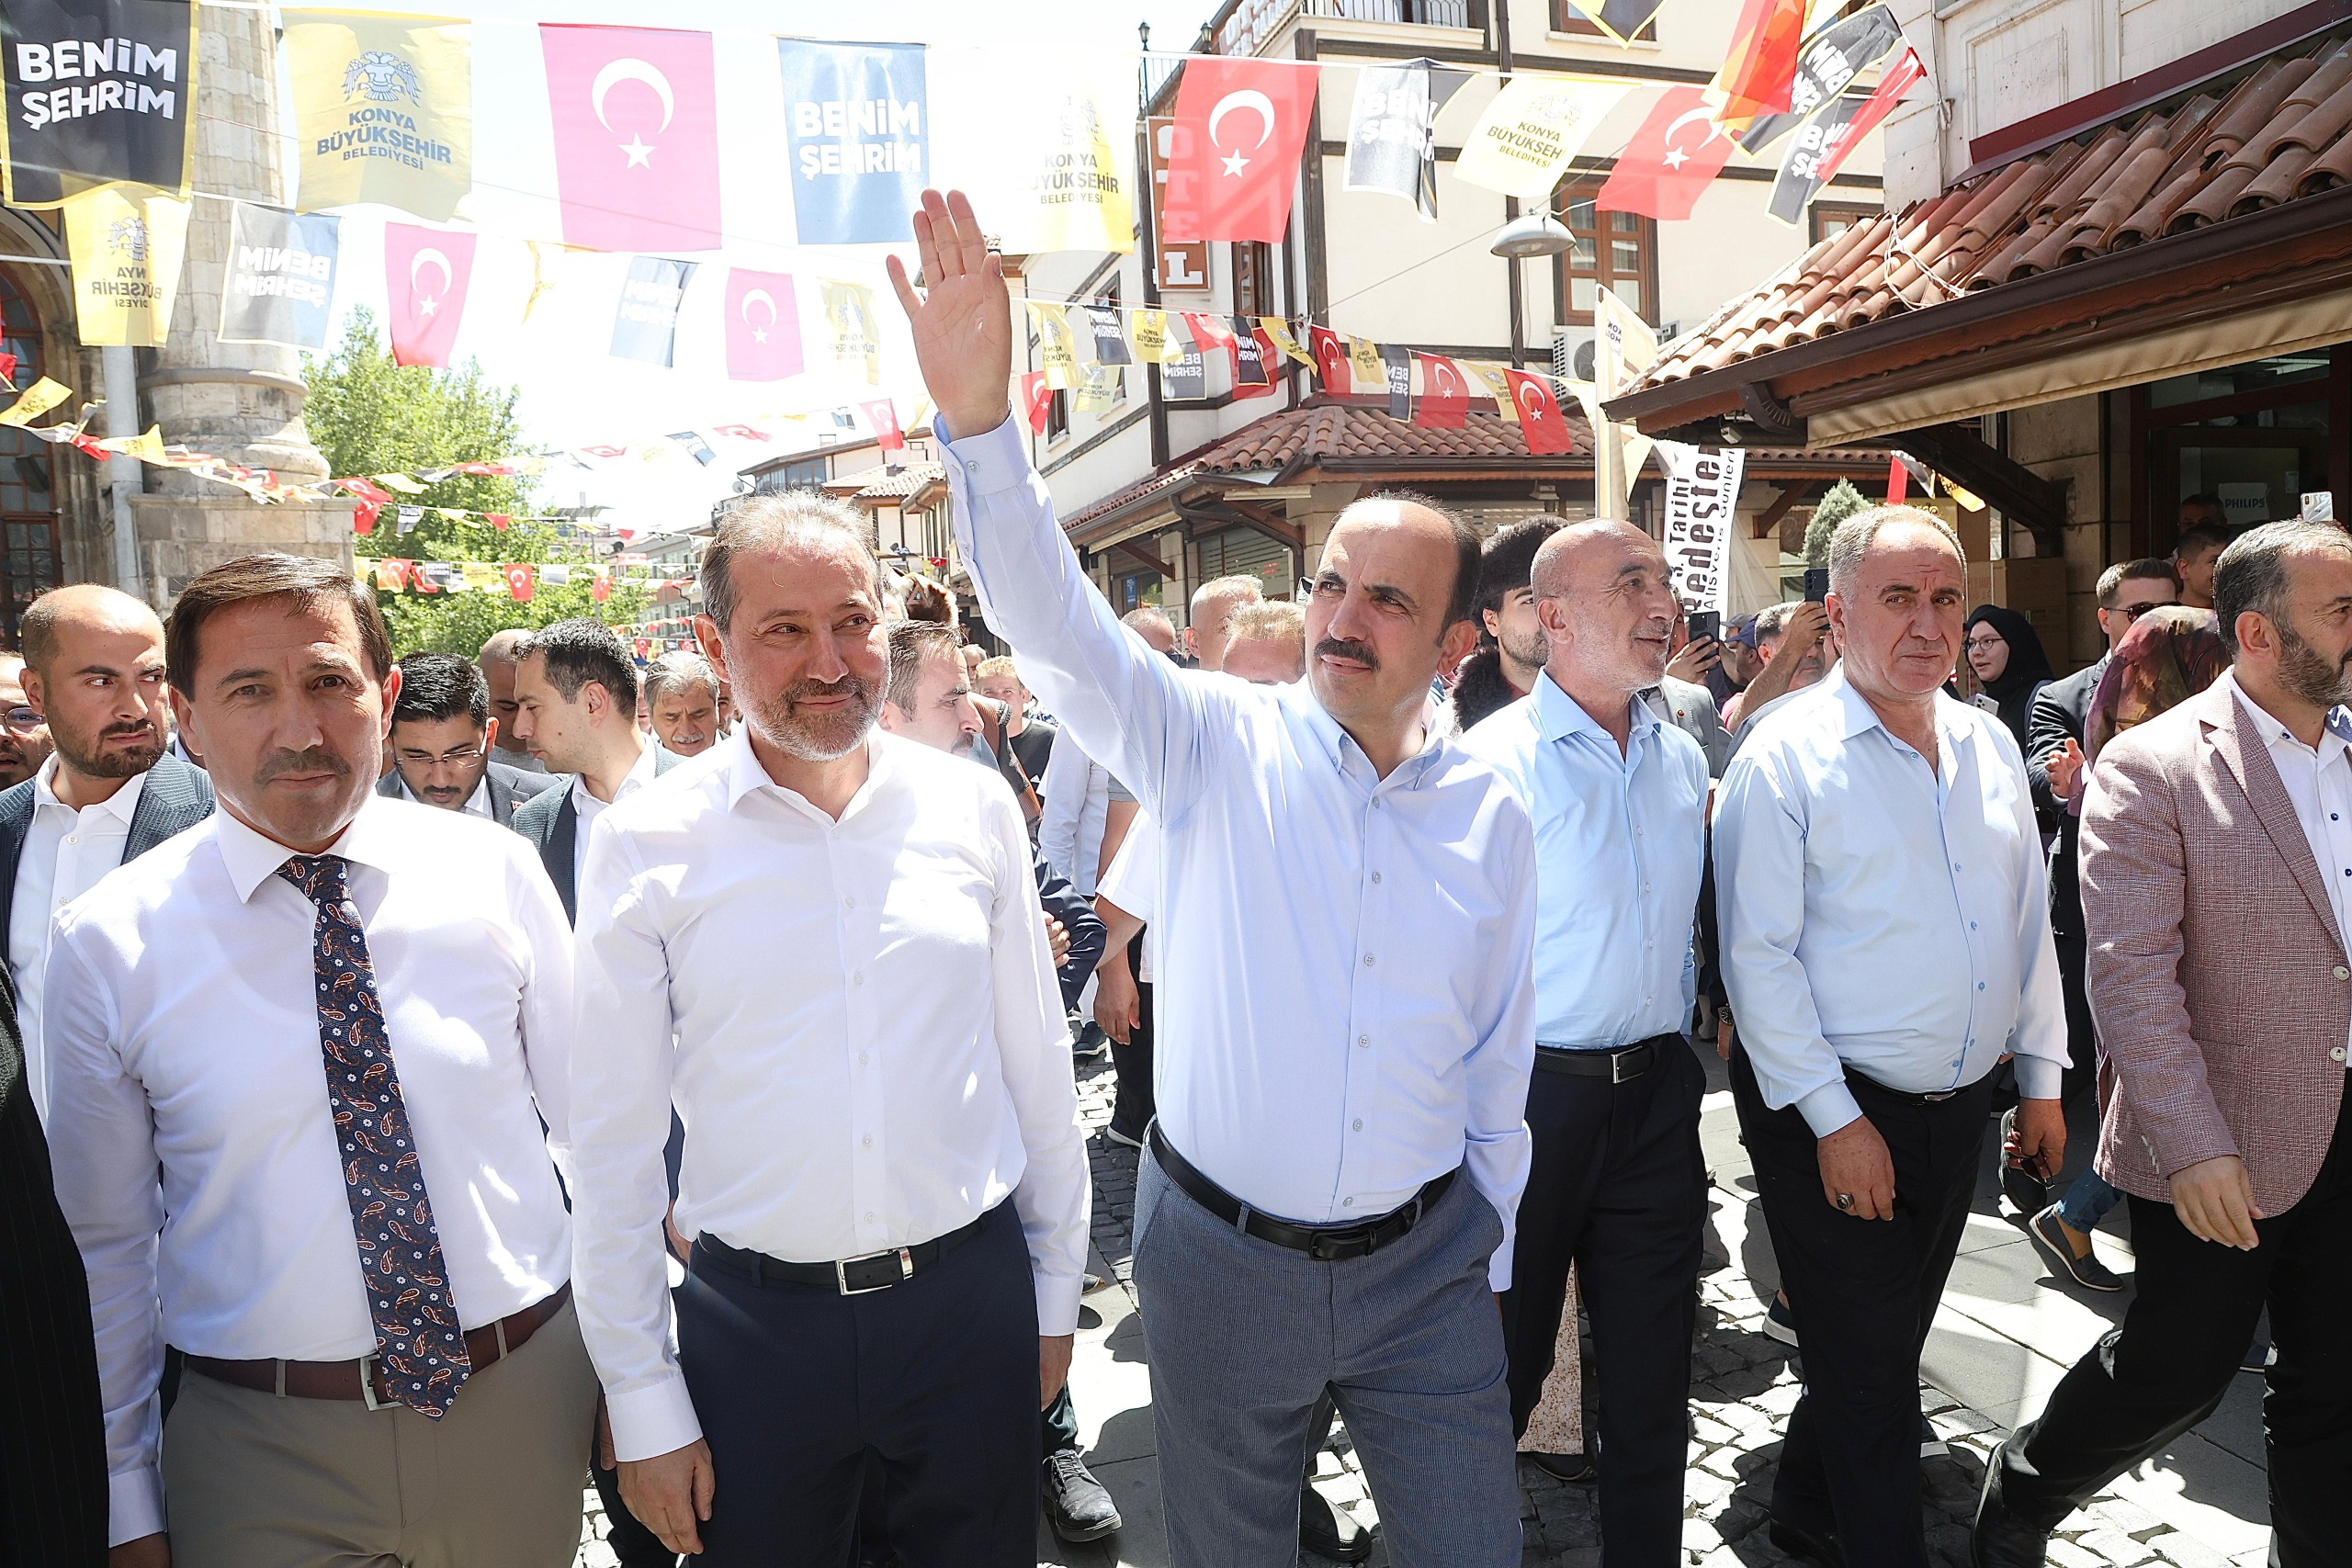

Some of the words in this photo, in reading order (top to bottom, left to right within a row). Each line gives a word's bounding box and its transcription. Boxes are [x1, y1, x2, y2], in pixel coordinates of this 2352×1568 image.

[16, 38, 177, 83] BENİM
[21, 80, 175, 130] ŞEHRİM
[349, 108, 417, 132] KONYA
[794, 98, 920, 137] BENİM
[1487, 126, 1564, 160] BÜYÜKŞEH
[1518, 121, 1561, 141] KONYA
[317, 123, 451, 164] BÜYÜKŞEHİR
[343, 146, 424, 170] BELEDİYESİ
[798, 141, 922, 181] ŞEHRİM
[1045, 153, 1098, 167] KONYA
[1016, 170, 1119, 194] ÜYÜKŞEHİR
[1040, 191, 1103, 204] BELEDİYESİ
[1238, 335, 1256, 349] NİM
[1238, 349, 1260, 361] HRİM
[1668, 477, 1690, 544] Tarihi
[2224, 498, 2266, 508] PHILIPS
